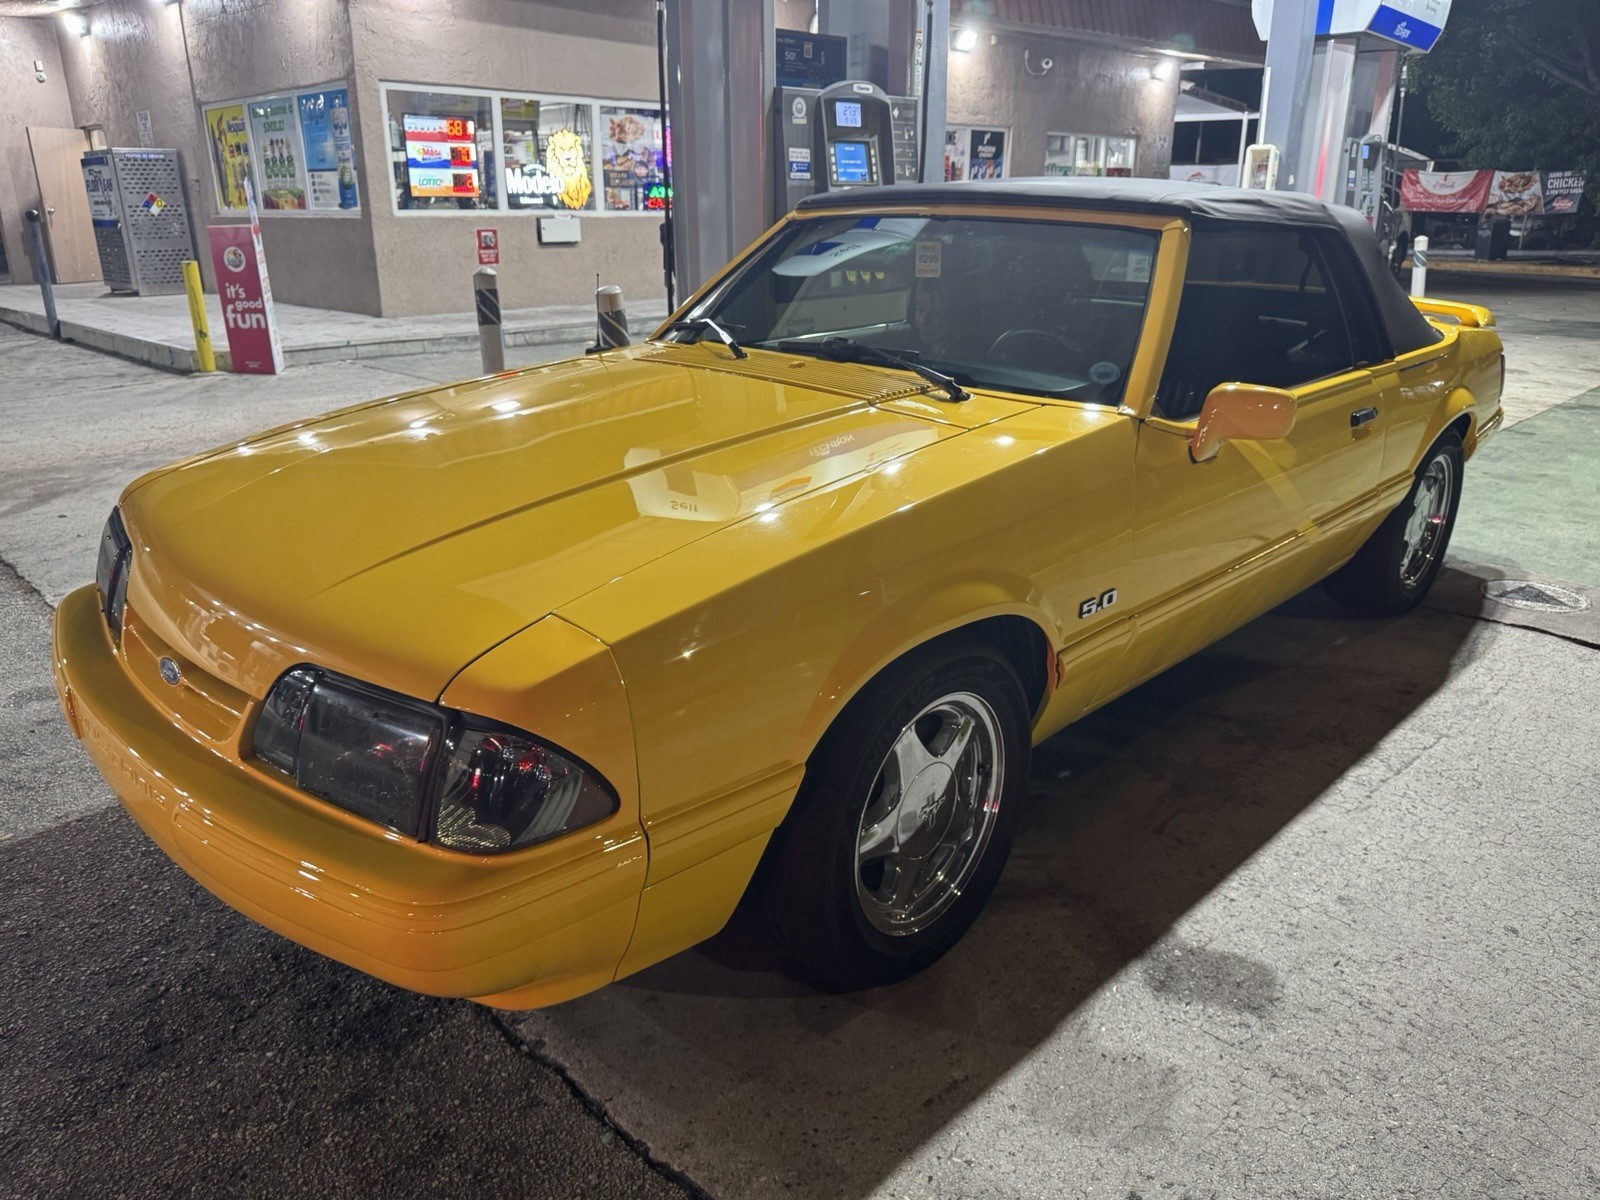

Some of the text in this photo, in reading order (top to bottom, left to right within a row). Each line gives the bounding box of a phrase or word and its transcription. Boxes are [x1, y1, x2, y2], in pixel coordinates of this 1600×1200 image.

[505, 167, 566, 194] Modelo
[1547, 177, 1585, 189] CHICKEN
[919, 254, 939, 264] 6290
[225, 282, 246, 299] it's
[235, 297, 263, 311] good
[226, 303, 266, 329] fun
[1079, 588, 1118, 619] 5.0
